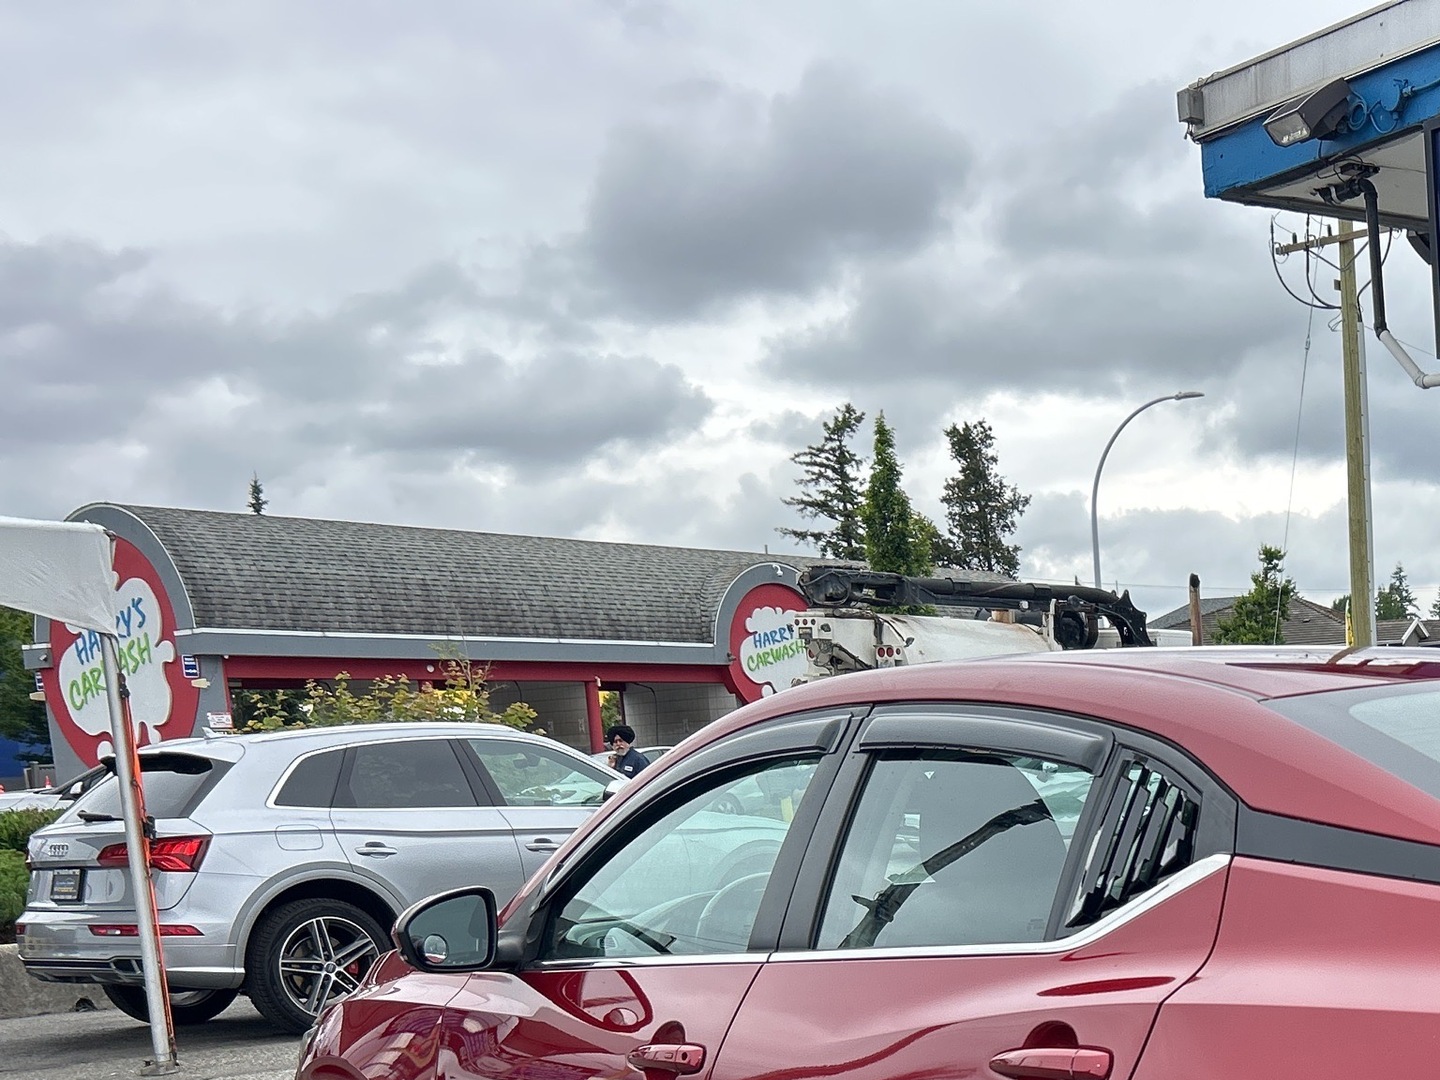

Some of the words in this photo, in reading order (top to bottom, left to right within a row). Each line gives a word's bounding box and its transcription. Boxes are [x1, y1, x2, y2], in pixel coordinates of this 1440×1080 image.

[74, 597, 146, 666] HAY'S
[746, 639, 806, 672] CARWASH
[752, 624, 796, 649] HARRY
[68, 632, 153, 711] CARASH
